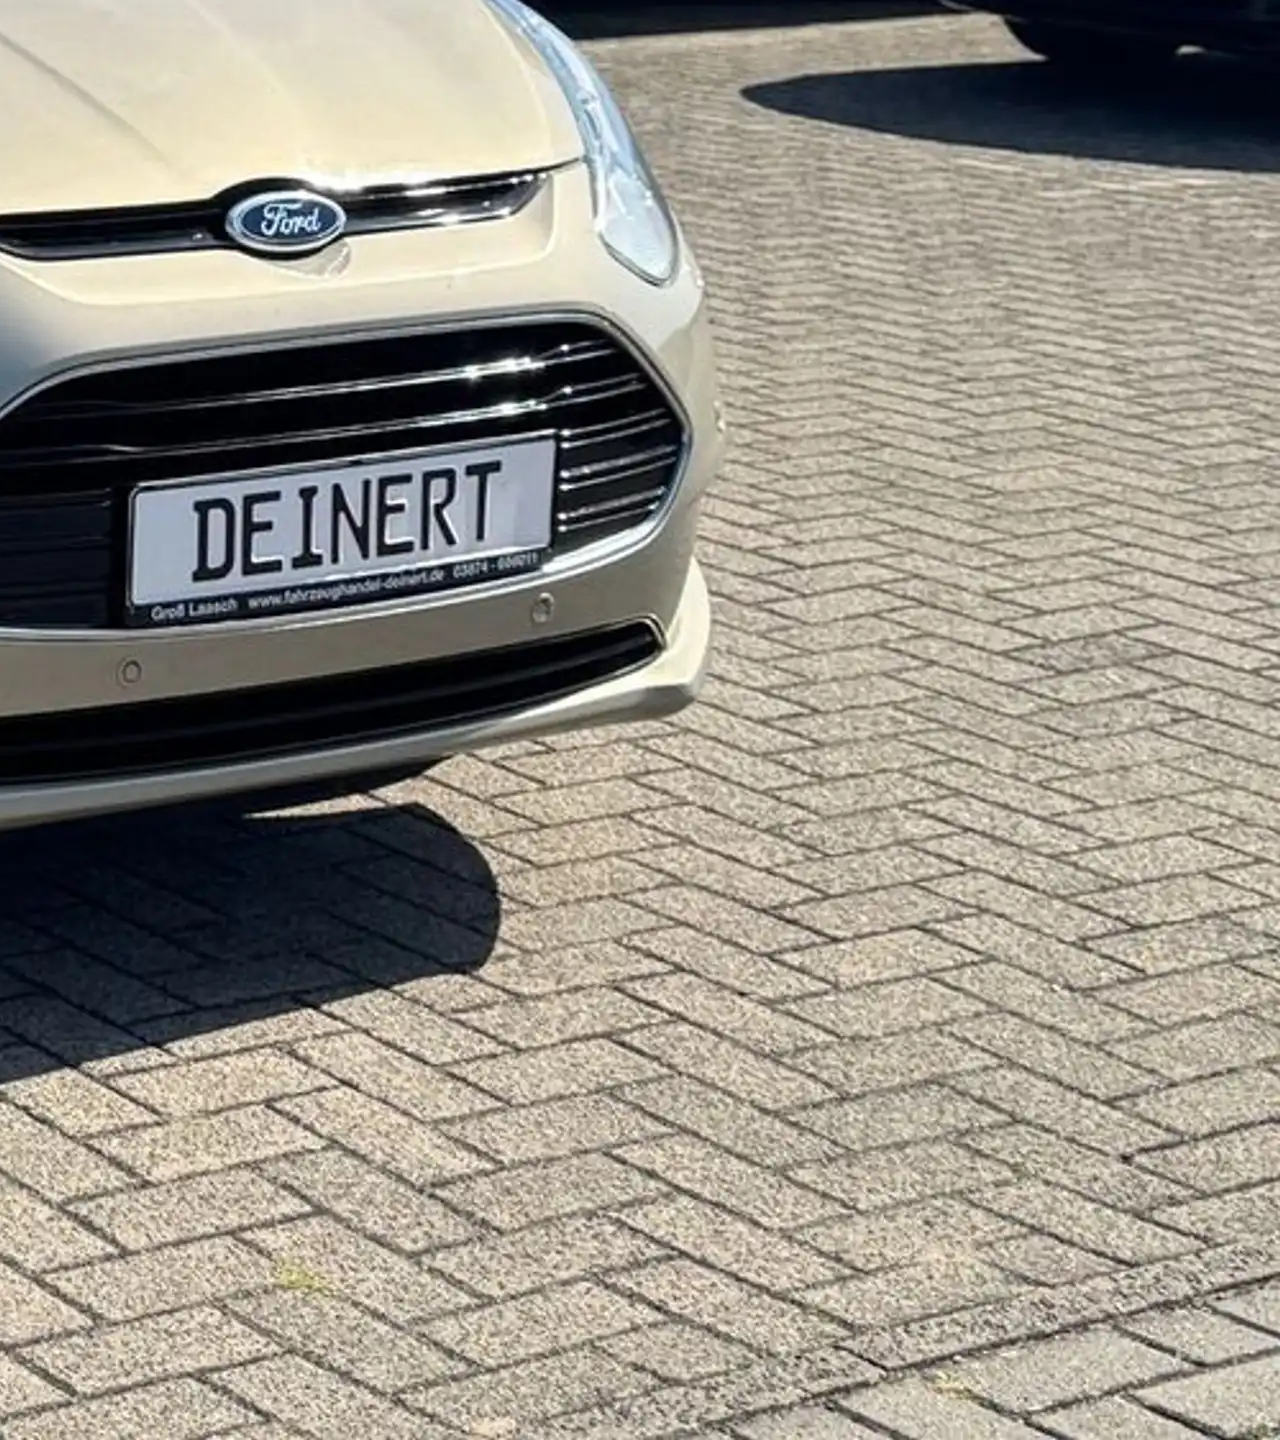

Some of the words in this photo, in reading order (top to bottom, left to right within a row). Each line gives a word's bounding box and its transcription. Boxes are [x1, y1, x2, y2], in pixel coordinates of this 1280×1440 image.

[260, 200, 322, 236] Ford
[191, 460, 503, 583] DEINERT
[150, 604, 186, 622] Groß
